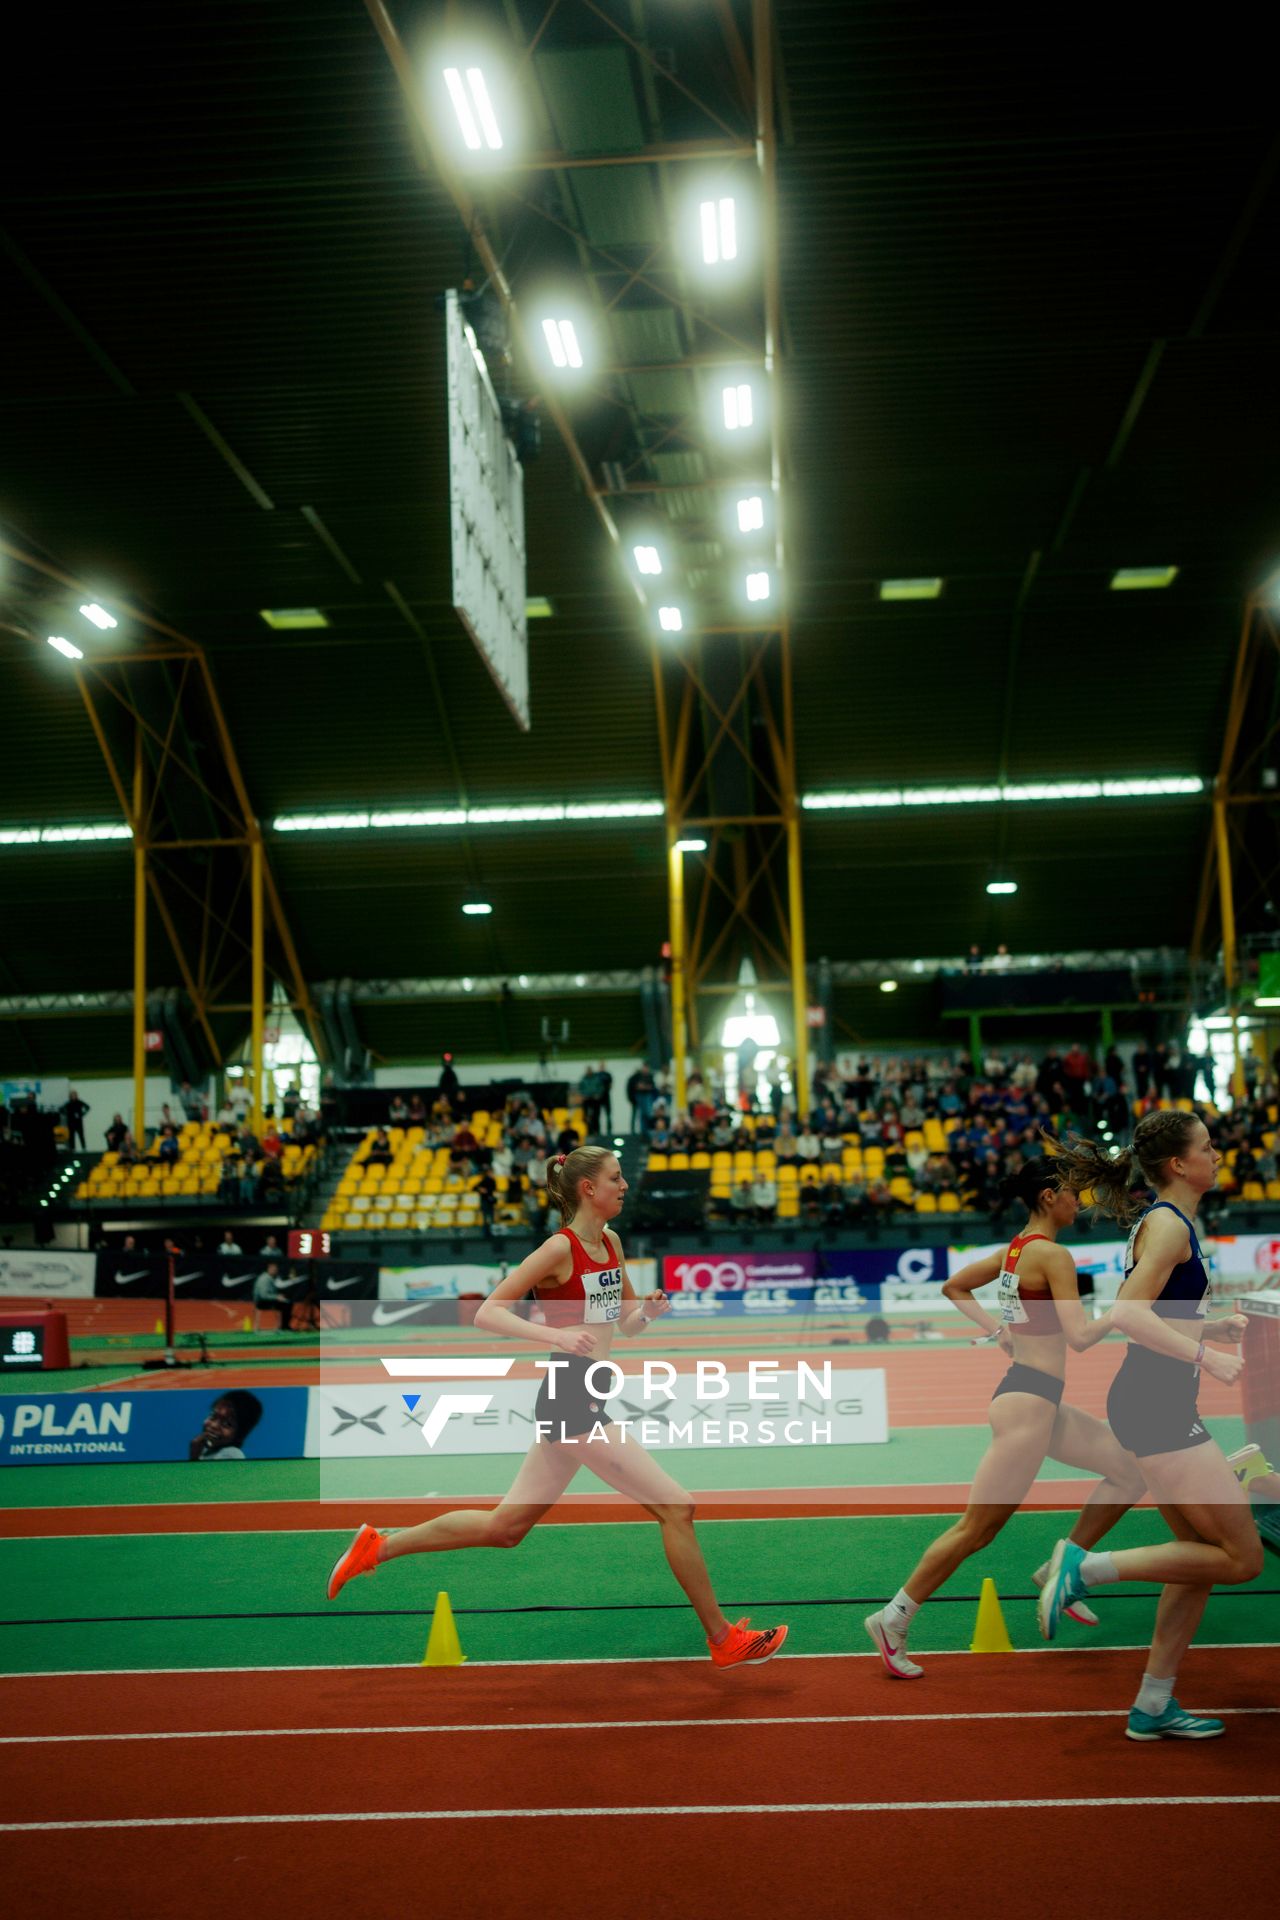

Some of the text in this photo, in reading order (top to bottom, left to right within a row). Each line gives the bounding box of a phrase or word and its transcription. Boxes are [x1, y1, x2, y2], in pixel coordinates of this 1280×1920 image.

[599, 1269, 621, 1287] GLS
[674, 1262, 745, 1291] 100
[670, 1291, 717, 1310] GLS
[743, 1288, 790, 1308] GLS
[813, 1286, 860, 1307] GLS
[401, 1409, 536, 1428] XPEN
[690, 1398, 863, 1420] XPENG
[12, 1402, 132, 1437] PLAN
[10, 1442, 126, 1455] INTERNATIONAL
